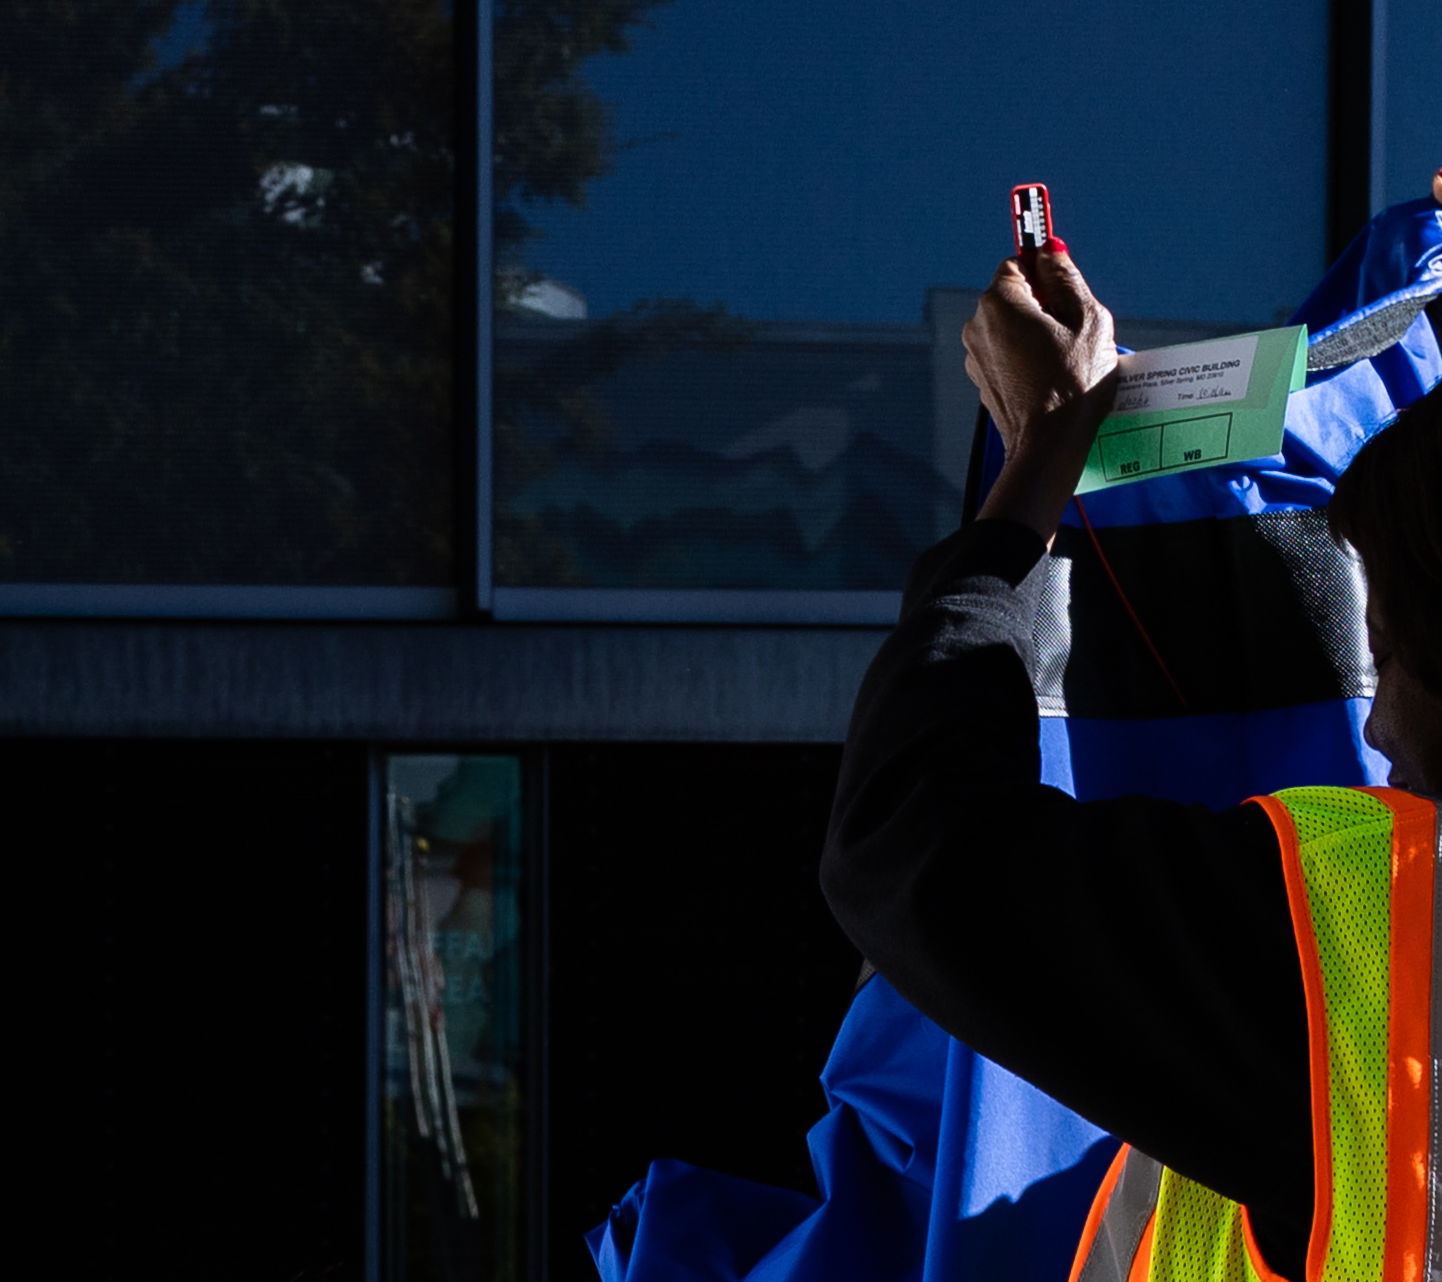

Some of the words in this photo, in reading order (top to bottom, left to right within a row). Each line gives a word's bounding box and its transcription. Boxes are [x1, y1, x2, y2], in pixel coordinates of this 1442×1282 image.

[1147, 368, 1177, 380] SPRING
[1179, 364, 1201, 376] CIVIC
[1202, 359, 1241, 372] BUILDING
[1183, 449, 1202, 462] WB
[1120, 461, 1141, 475] REG
